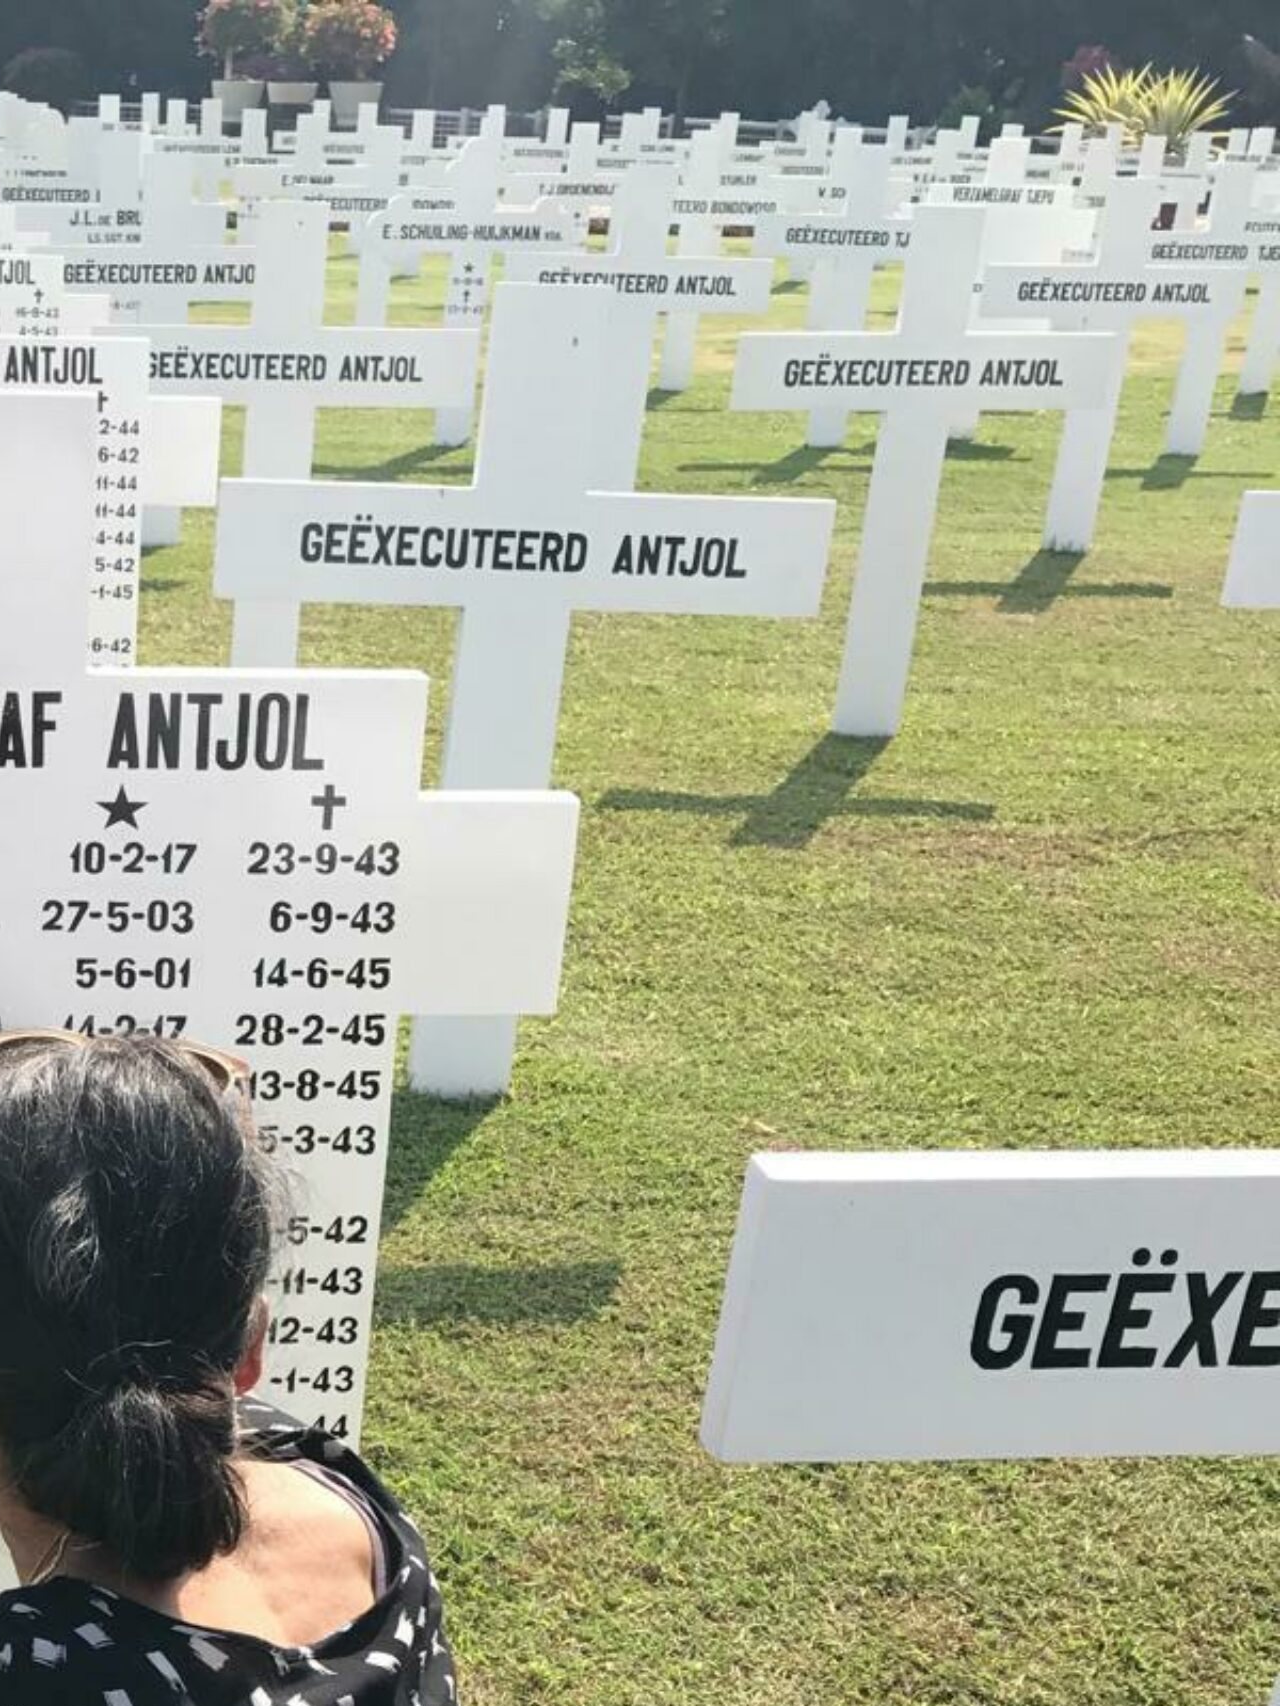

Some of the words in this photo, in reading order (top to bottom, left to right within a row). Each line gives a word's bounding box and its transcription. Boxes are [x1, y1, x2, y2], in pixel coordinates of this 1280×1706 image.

[785, 224, 890, 246] GEËXECUTEERD
[63, 259, 197, 285] GEËXECUTEERD
[673, 274, 737, 296] ANTJOL
[1017, 276, 1147, 302] GEËXECUTEERD
[1151, 282, 1212, 304] ANTJOL
[4, 345, 103, 385] ANTJOL
[338, 354, 423, 383] ANTJOL
[783, 353, 970, 388] GEËXECUTEERD
[979, 358, 1064, 387] ANTJOL
[299, 514, 588, 573] GEËXECUTEERD
[611, 533, 747, 579] ANTJOL
[107, 692, 325, 771] ANTJOL
[70, 841, 198, 875] 10-2-17
[247, 841, 401, 876] 23-9-43
[41, 899, 195, 933] 27-5-03
[269, 901, 396, 934] 6-9-43
[75, 957, 191, 989] 5-6-01
[253, 957, 392, 990] 14-6-45
[234, 1013, 387, 1047] 28-2-45
[969, 1247, 1280, 1371] GEËXE
